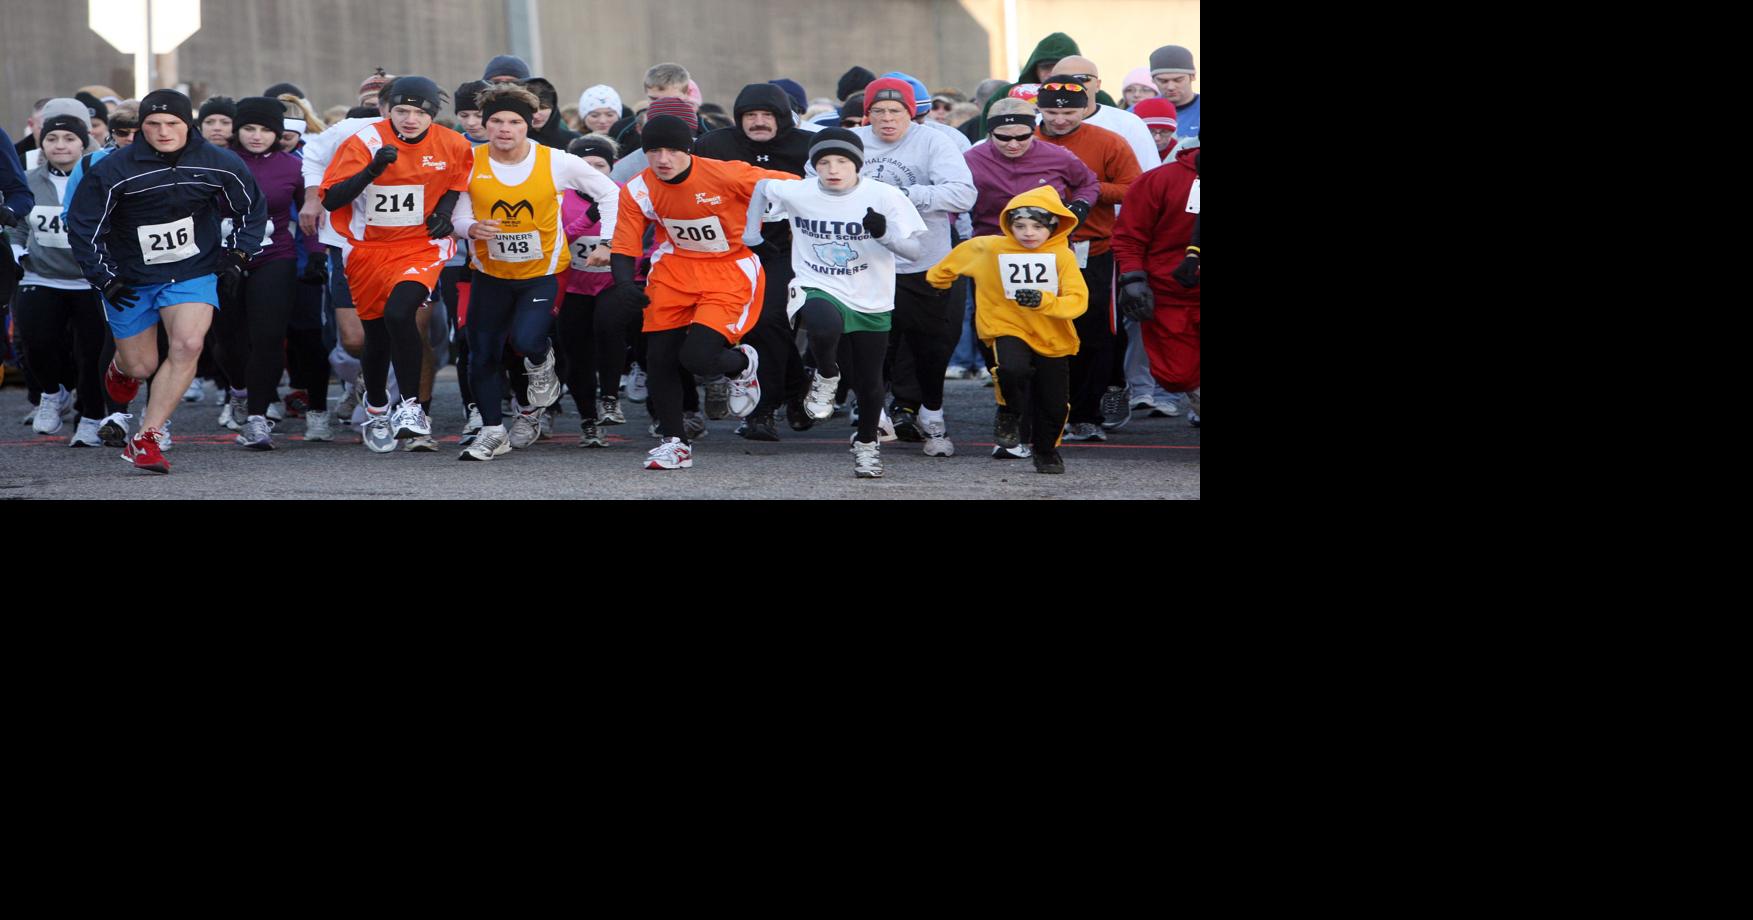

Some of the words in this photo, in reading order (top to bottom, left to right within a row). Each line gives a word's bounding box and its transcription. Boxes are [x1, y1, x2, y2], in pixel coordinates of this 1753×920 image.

[375, 193, 414, 212] 214
[672, 224, 716, 242] 206
[794, 216, 871, 236] MILTO
[148, 227, 188, 251] 216
[496, 233, 533, 241] UNNERS
[497, 241, 529, 254] 143
[1008, 262, 1049, 284] 212
